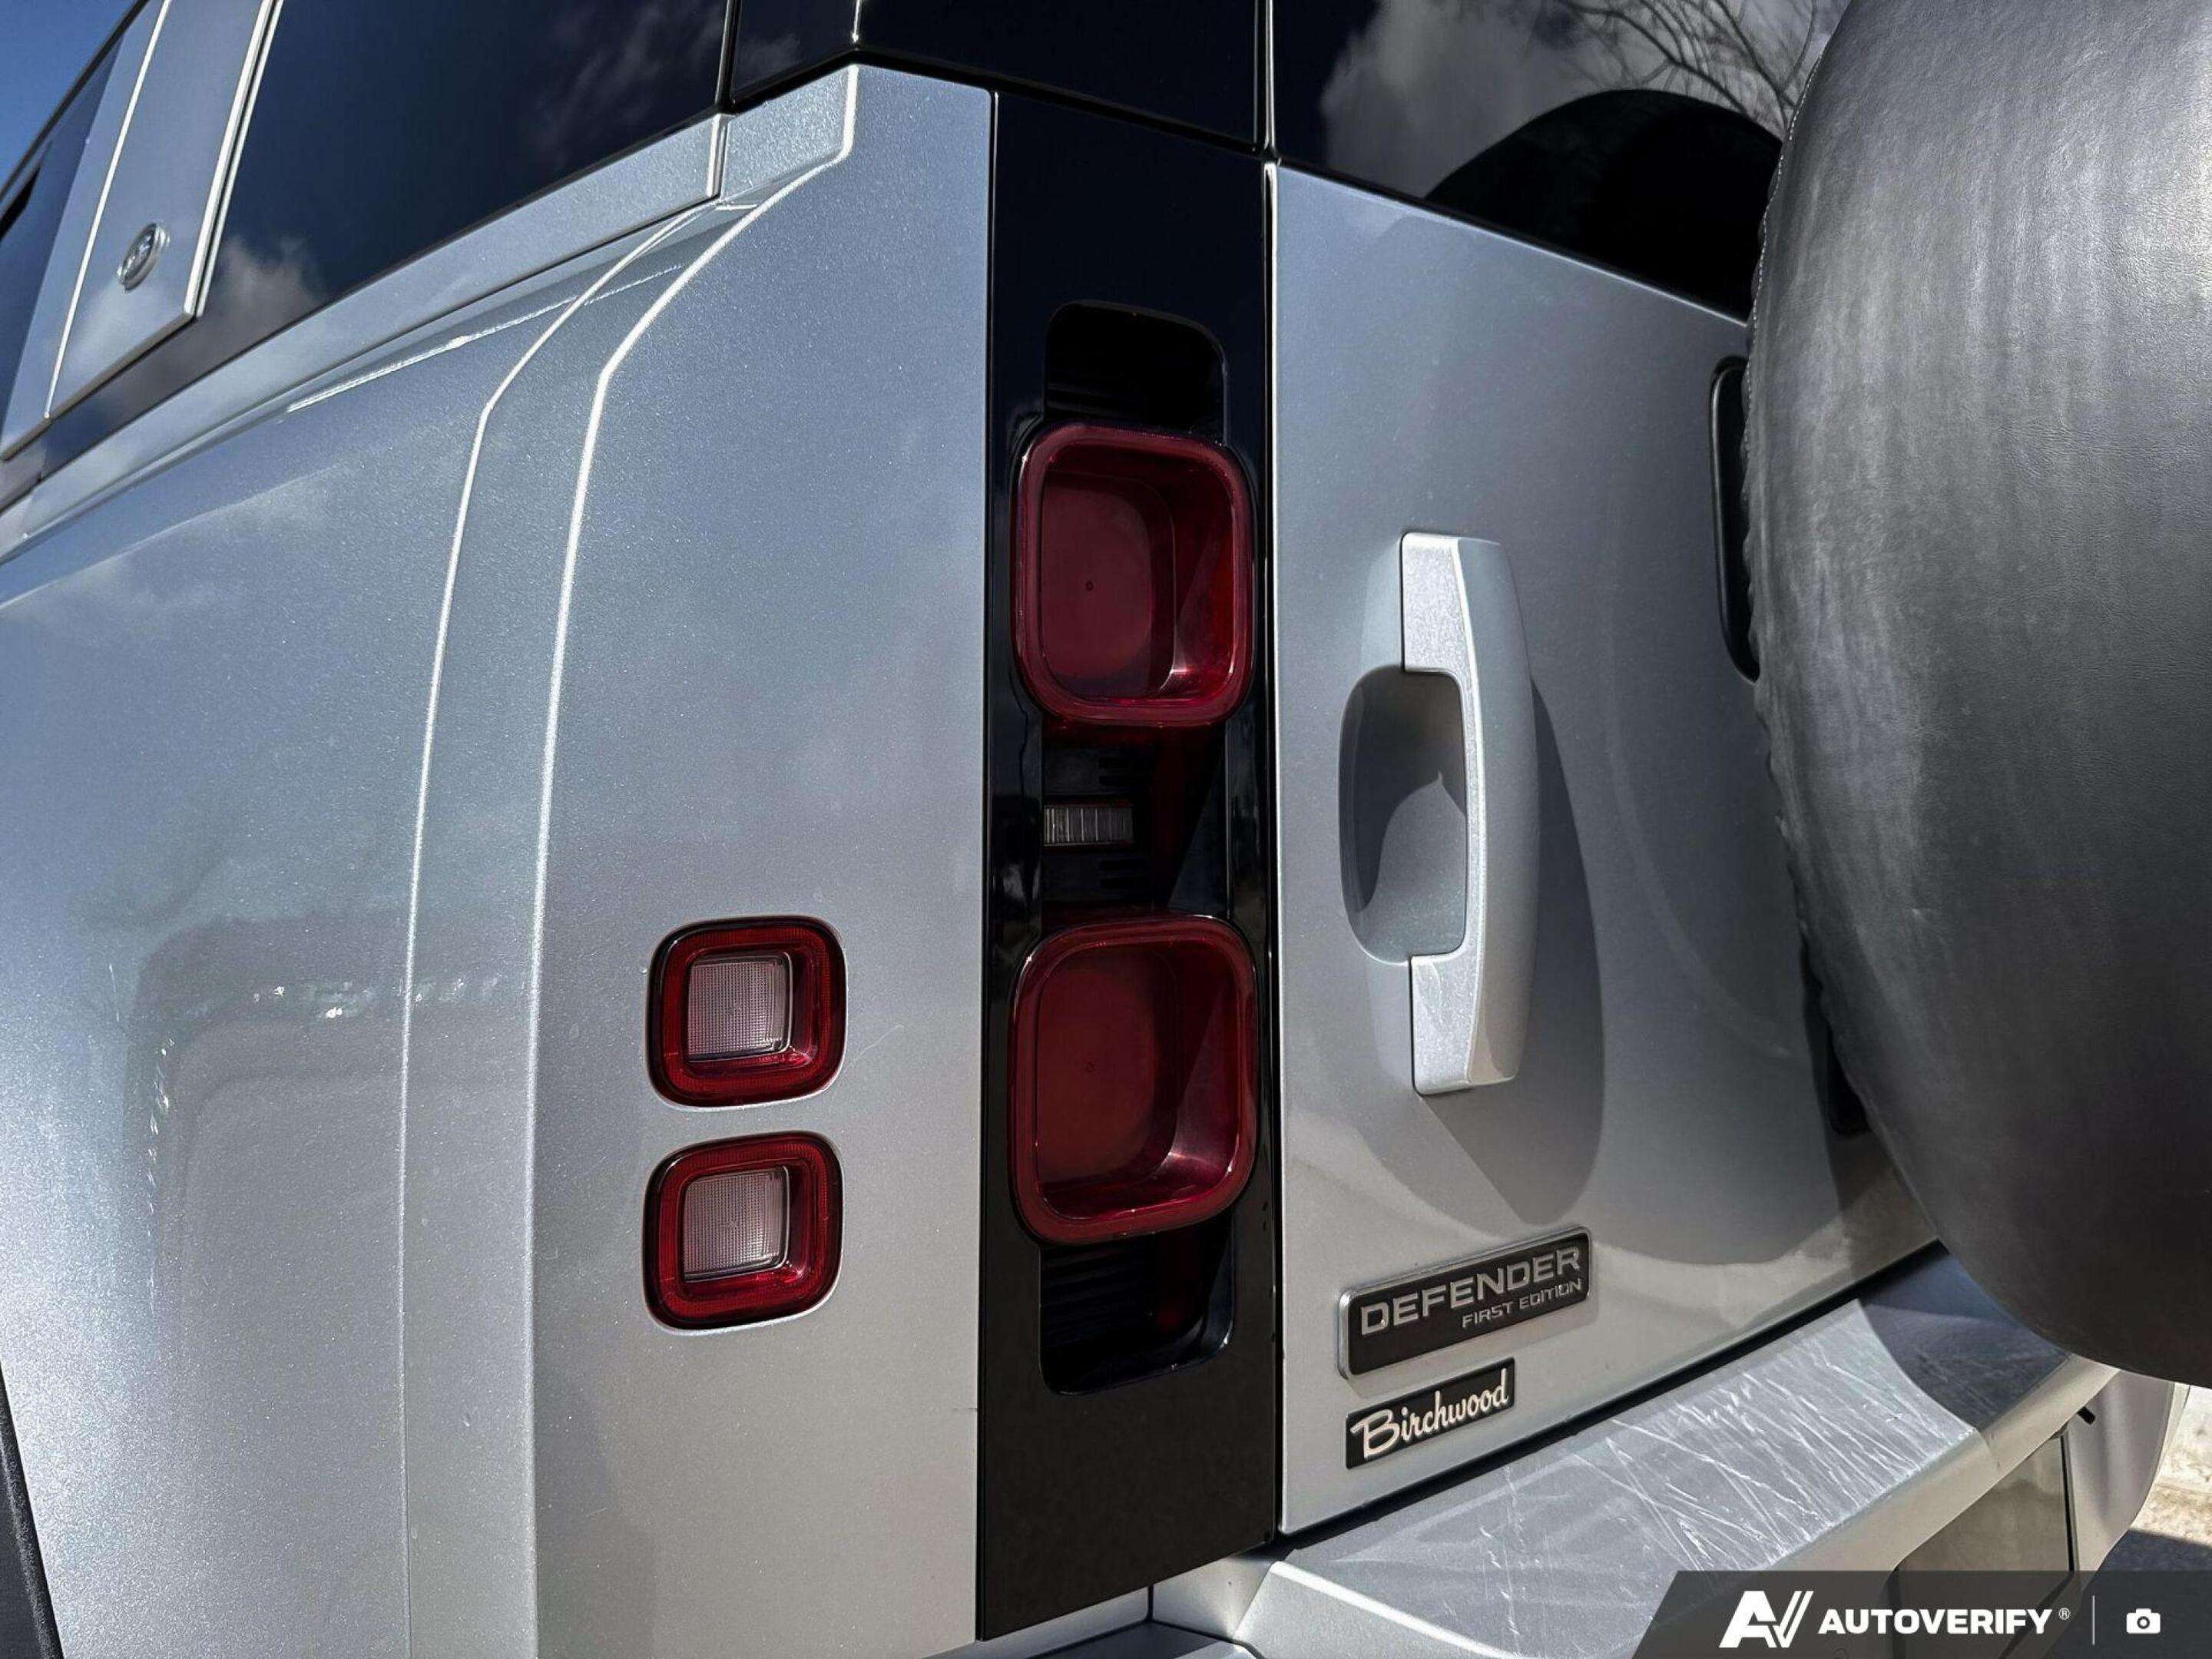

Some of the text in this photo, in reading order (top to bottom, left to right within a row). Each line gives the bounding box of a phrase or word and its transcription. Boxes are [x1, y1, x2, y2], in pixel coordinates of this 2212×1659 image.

[1361, 1247, 1580, 1336] DEFENDER
[1462, 1279, 1583, 1329] FIRST EDITION
[1350, 1368, 1509, 1459] Birchwood
